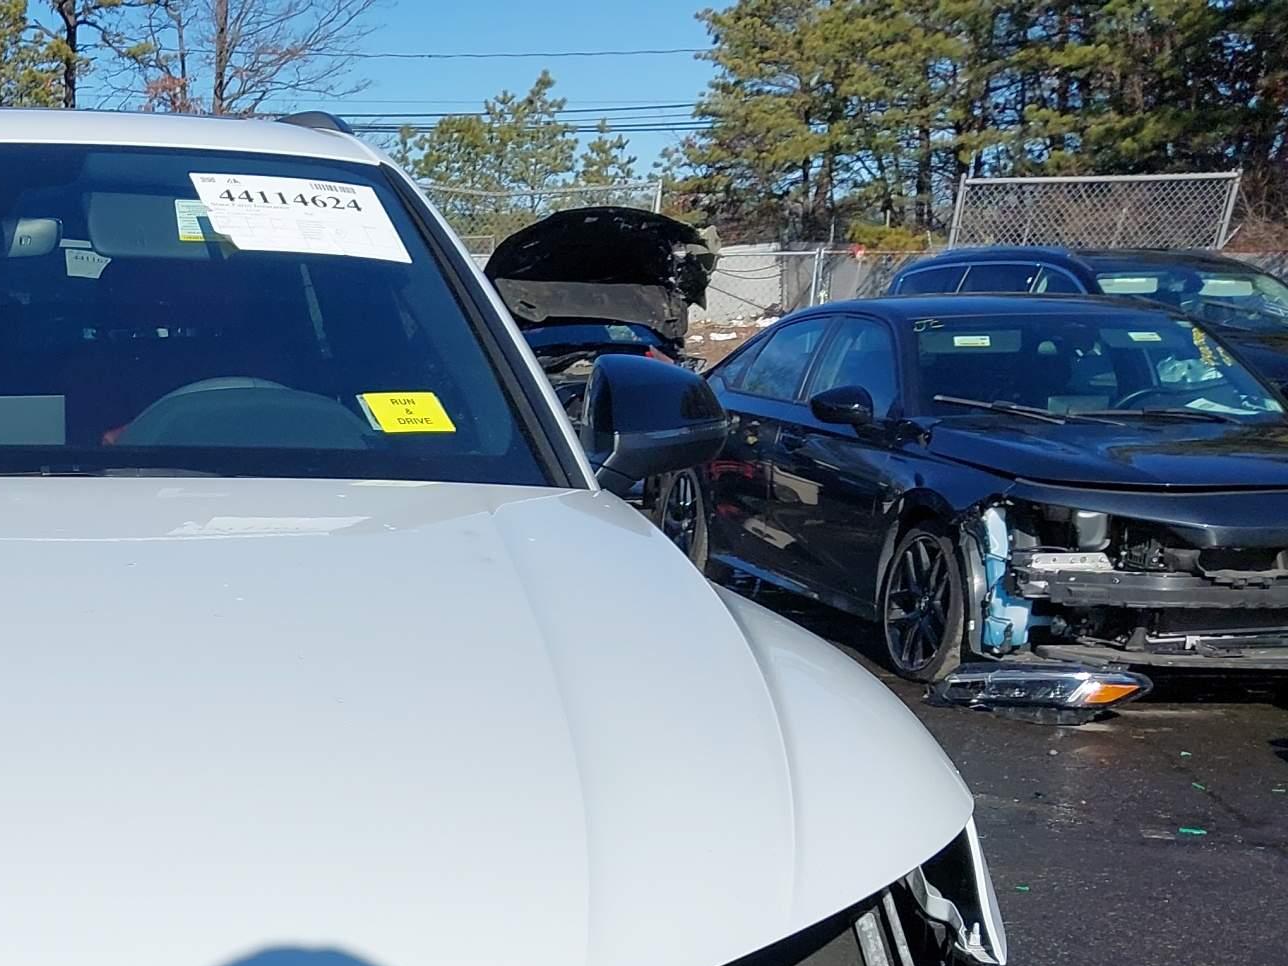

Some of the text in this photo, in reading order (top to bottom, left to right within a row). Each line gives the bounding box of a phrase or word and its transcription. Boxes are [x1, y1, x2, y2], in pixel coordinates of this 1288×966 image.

[218, 189, 363, 212] 44114624
[389, 398, 416, 406] RUN
[397, 417, 434, 425] DRIVE
